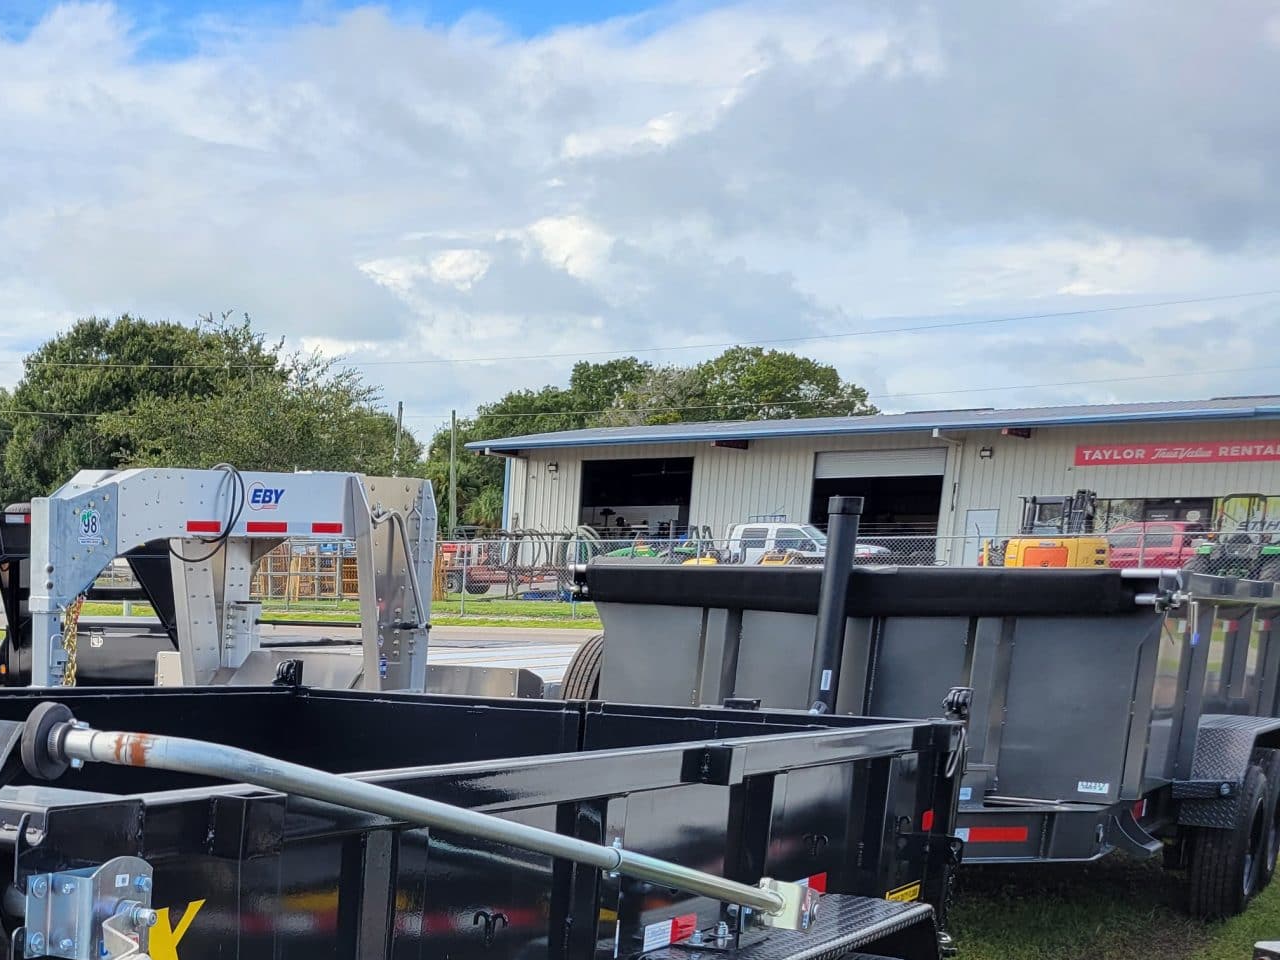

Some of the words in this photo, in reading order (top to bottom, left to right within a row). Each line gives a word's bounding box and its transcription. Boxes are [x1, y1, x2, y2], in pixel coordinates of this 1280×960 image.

[1082, 449, 1145, 461] TAYLOR
[251, 488, 286, 504] EBY
[83, 515, 97, 533] 98
